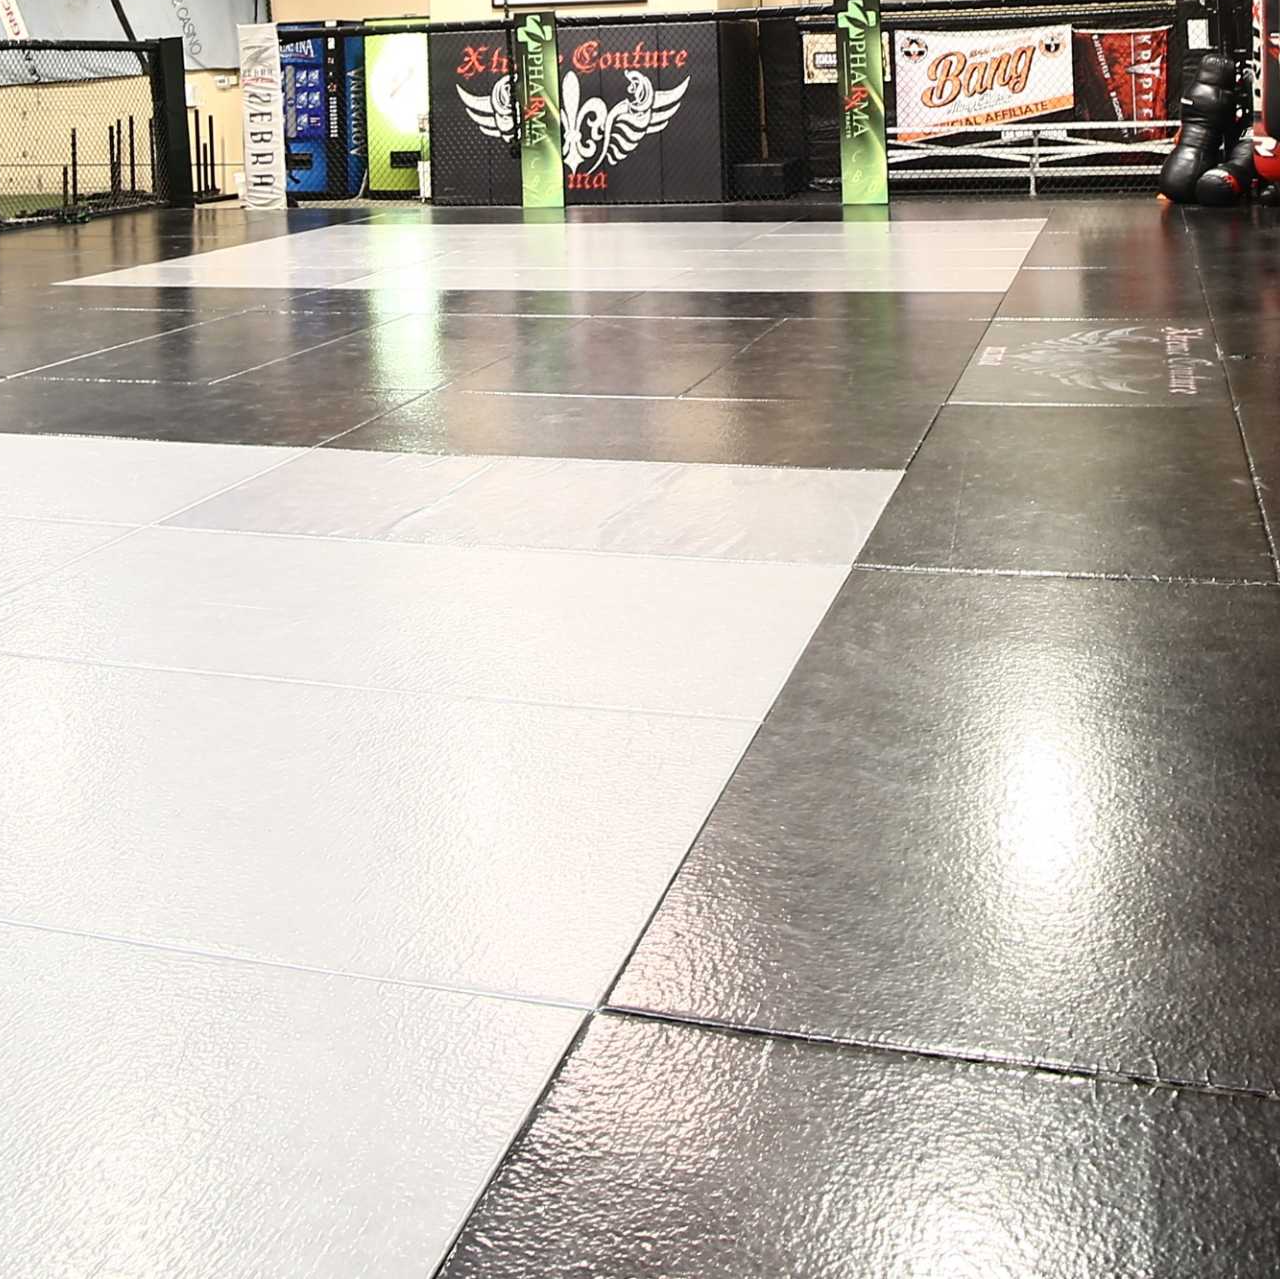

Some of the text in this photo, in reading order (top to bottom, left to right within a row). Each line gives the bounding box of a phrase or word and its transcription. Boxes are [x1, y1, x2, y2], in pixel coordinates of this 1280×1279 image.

[177, 7, 202, 55] CASINO
[573, 40, 688, 74] Couture
[528, 56, 548, 146] PHARMA
[849, 40, 871, 139] PHARMA
[921, 45, 1036, 109] Bang
[249, 93, 275, 187] ZEBRA
[985, 102, 1049, 122] AFFILIATE
